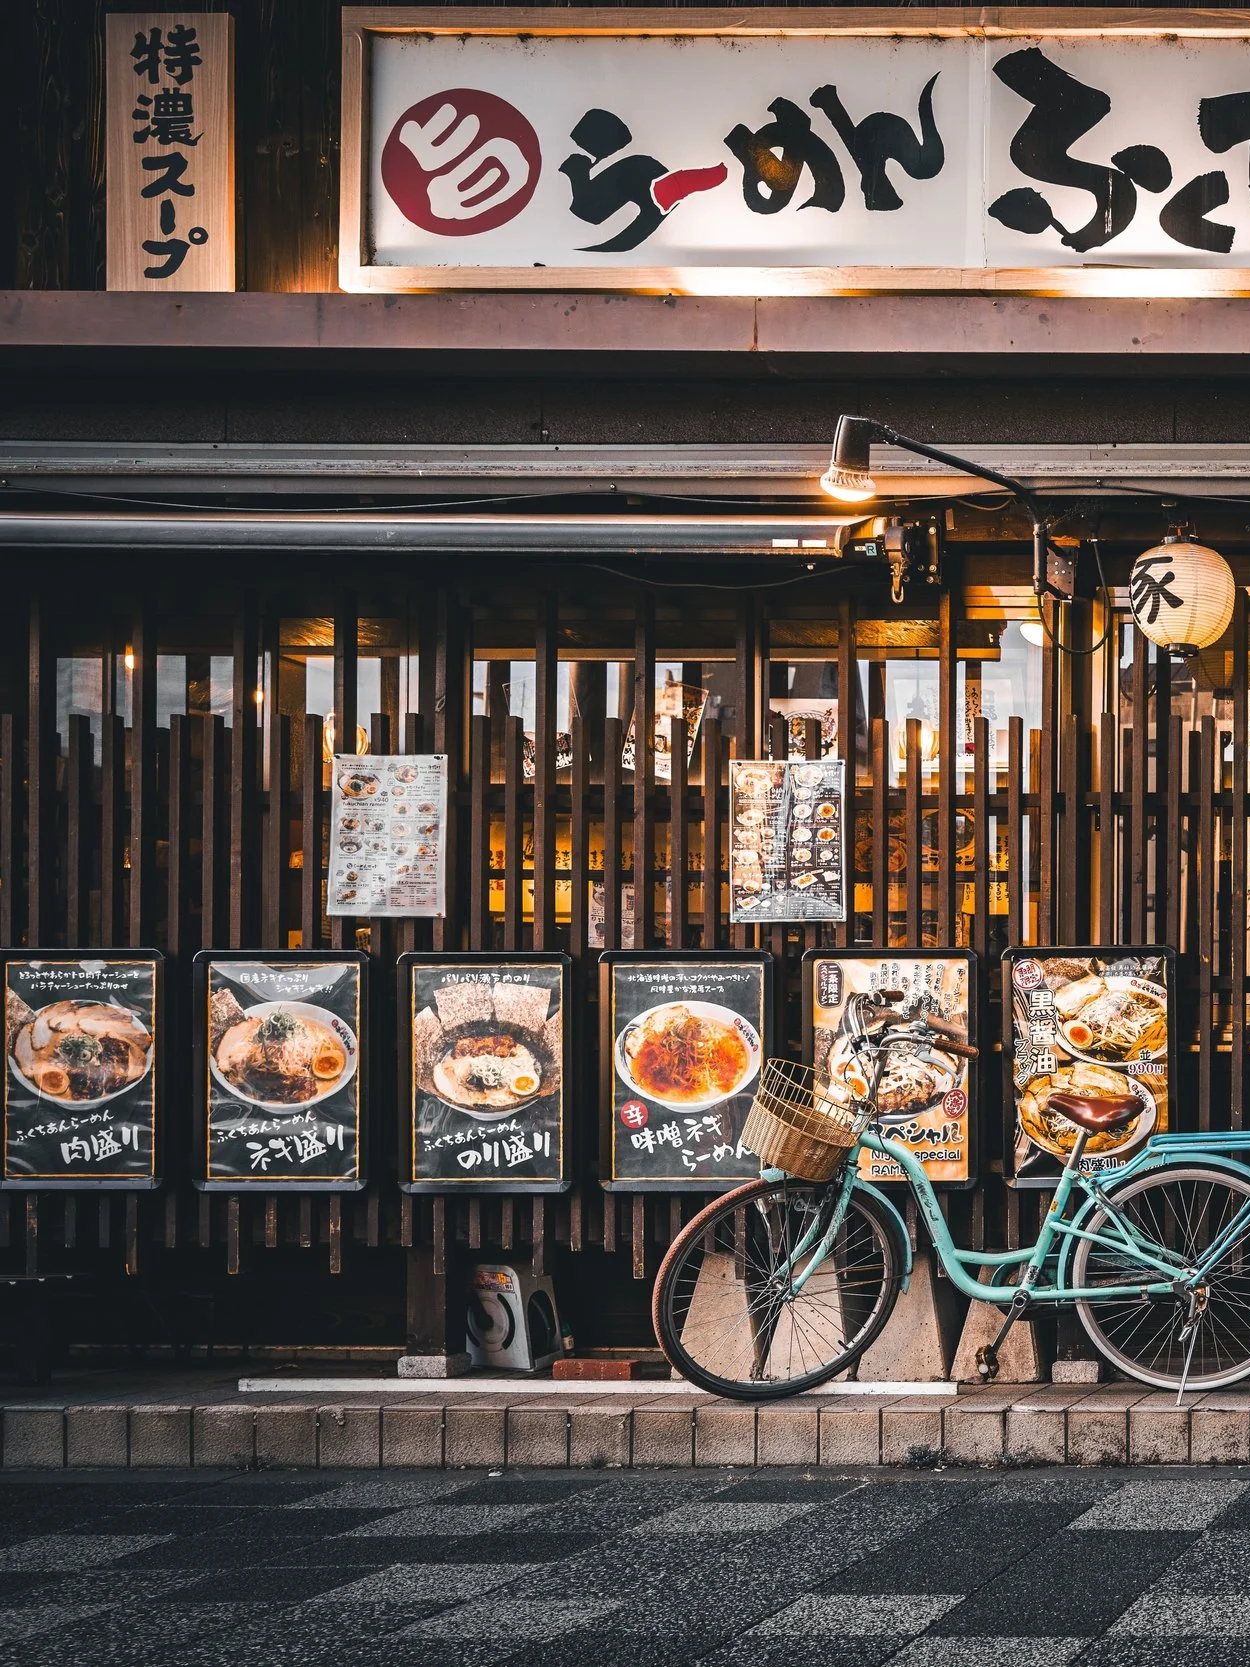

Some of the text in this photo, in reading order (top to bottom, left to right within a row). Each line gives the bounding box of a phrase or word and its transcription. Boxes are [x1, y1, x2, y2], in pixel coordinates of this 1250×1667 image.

[131, 24, 210, 280] 特濃スープ
[559, 70, 945, 252] らーめん
[828, 965, 838, 1004] 二条限定
[1028, 989, 1058, 1075] 黒醤油
[1014, 1039, 1030, 1085] ブラック
[1128, 1063, 1165, 1075] 990円
[1139, 1050, 1151, 1062] 並
[15, 1109, 115, 1143] ふくちあんらーめん
[216, 1110, 317, 1144] ふくちあんらーめん
[624, 1104, 645, 1126] 辛
[60, 1125, 140, 1165] 肉盛り
[246, 1125, 344, 1171] ネギ盛り
[423, 1118, 522, 1152] ふくちあんらーめん
[457, 1131, 551, 1169] のり盛り
[681, 1139, 755, 1172] らーめん
[914, 1149, 960, 1162] special
